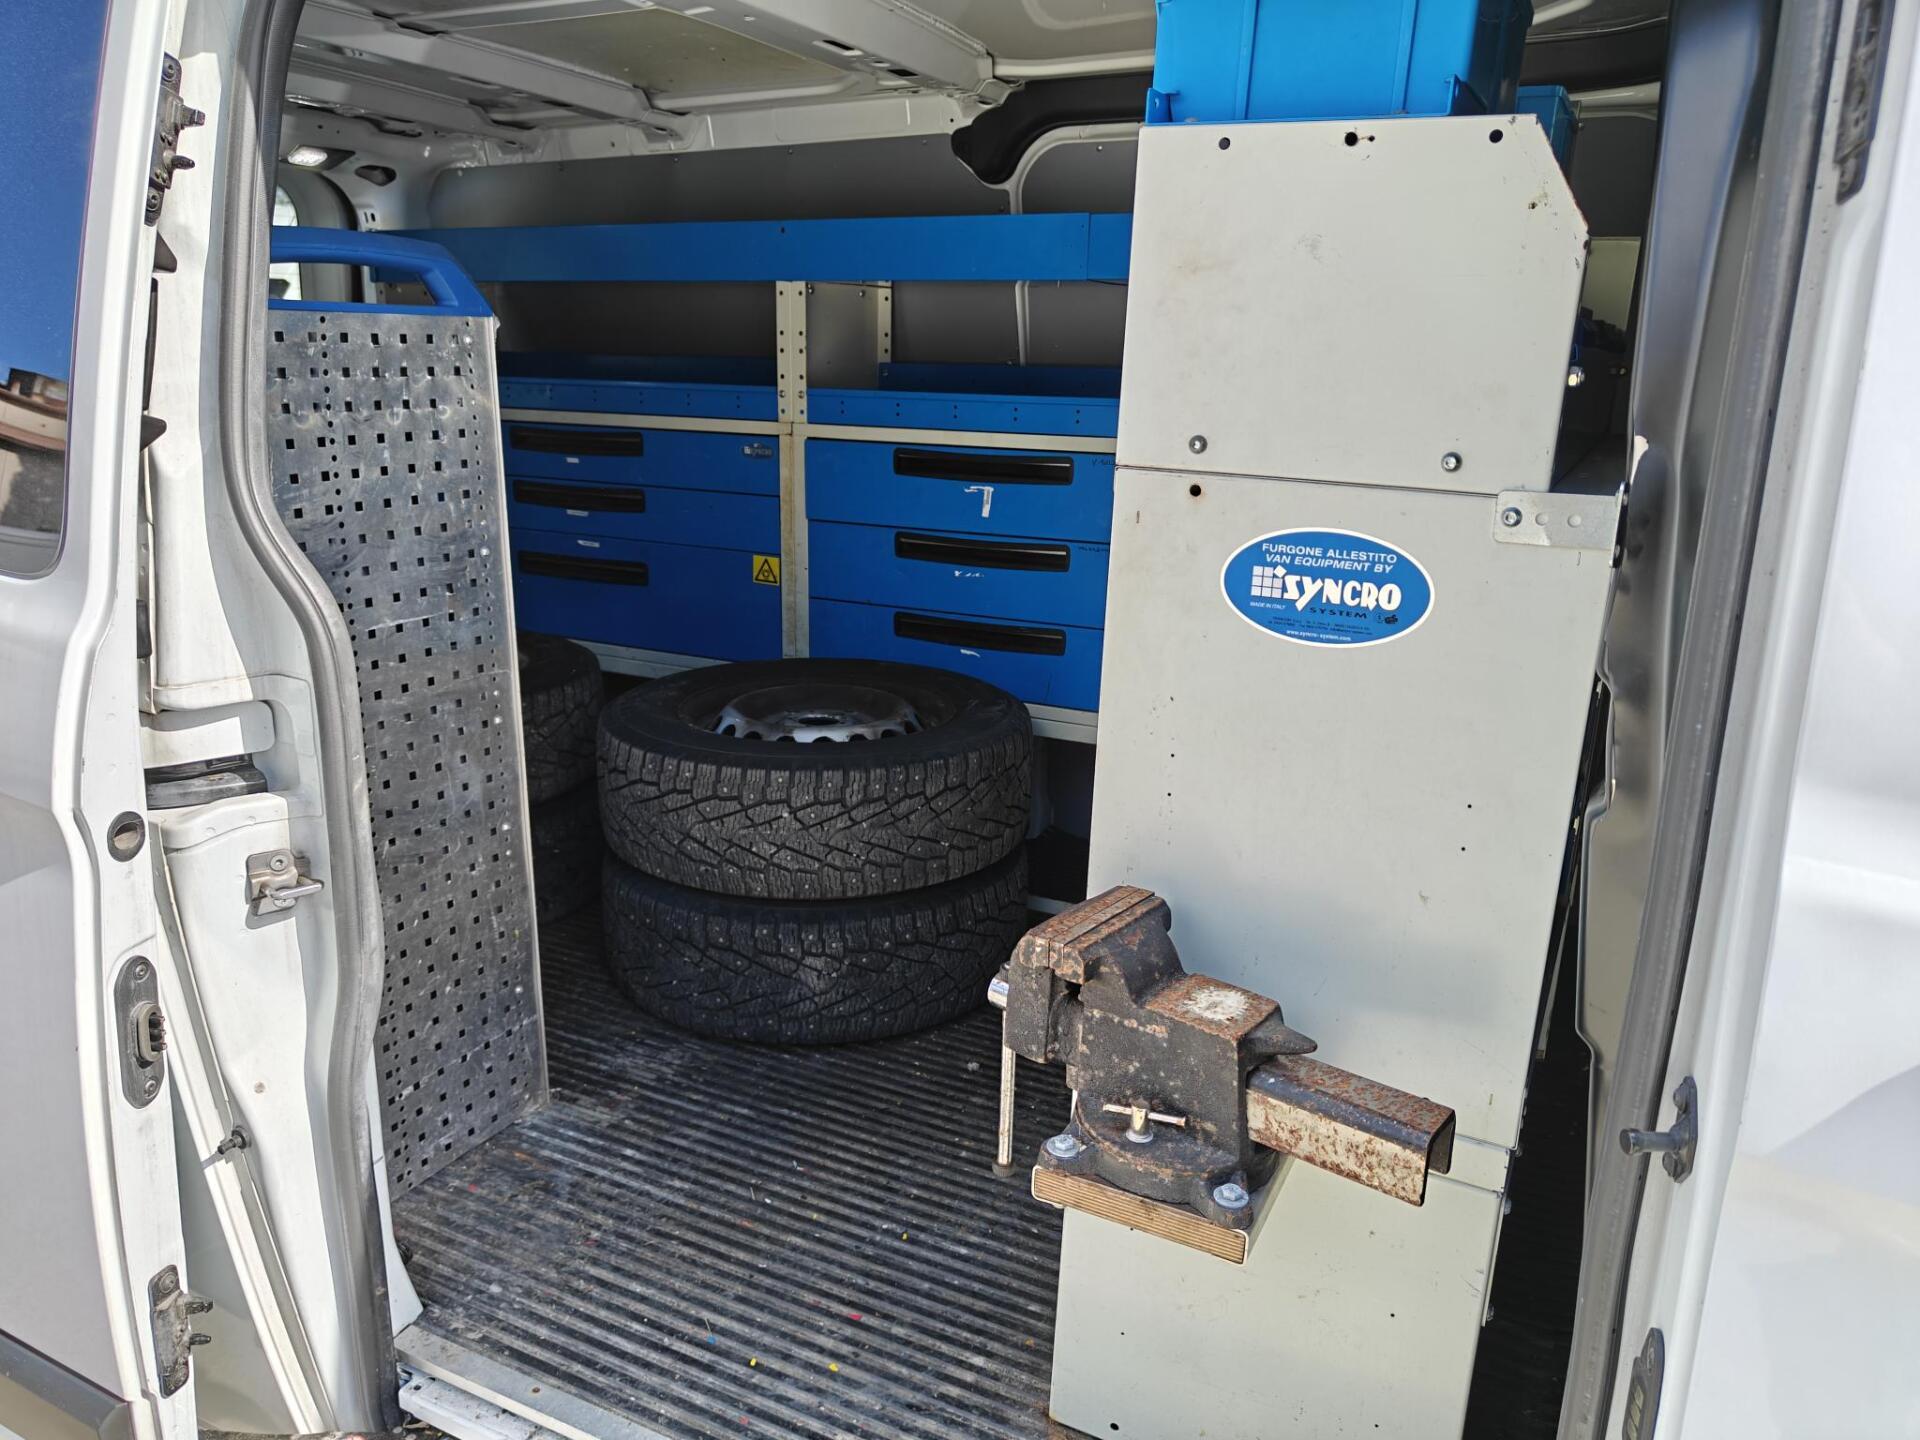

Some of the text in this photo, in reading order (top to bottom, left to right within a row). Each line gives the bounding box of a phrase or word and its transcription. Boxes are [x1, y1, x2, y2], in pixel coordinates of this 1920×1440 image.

[1262, 543, 1398, 564] FURGONE ALLESTITO
[1265, 553, 1394, 574] VAN EQUIPMENT BY
[1283, 574, 1402, 611] SYNCRO
[1309, 607, 1367, 619] SYSTEM
